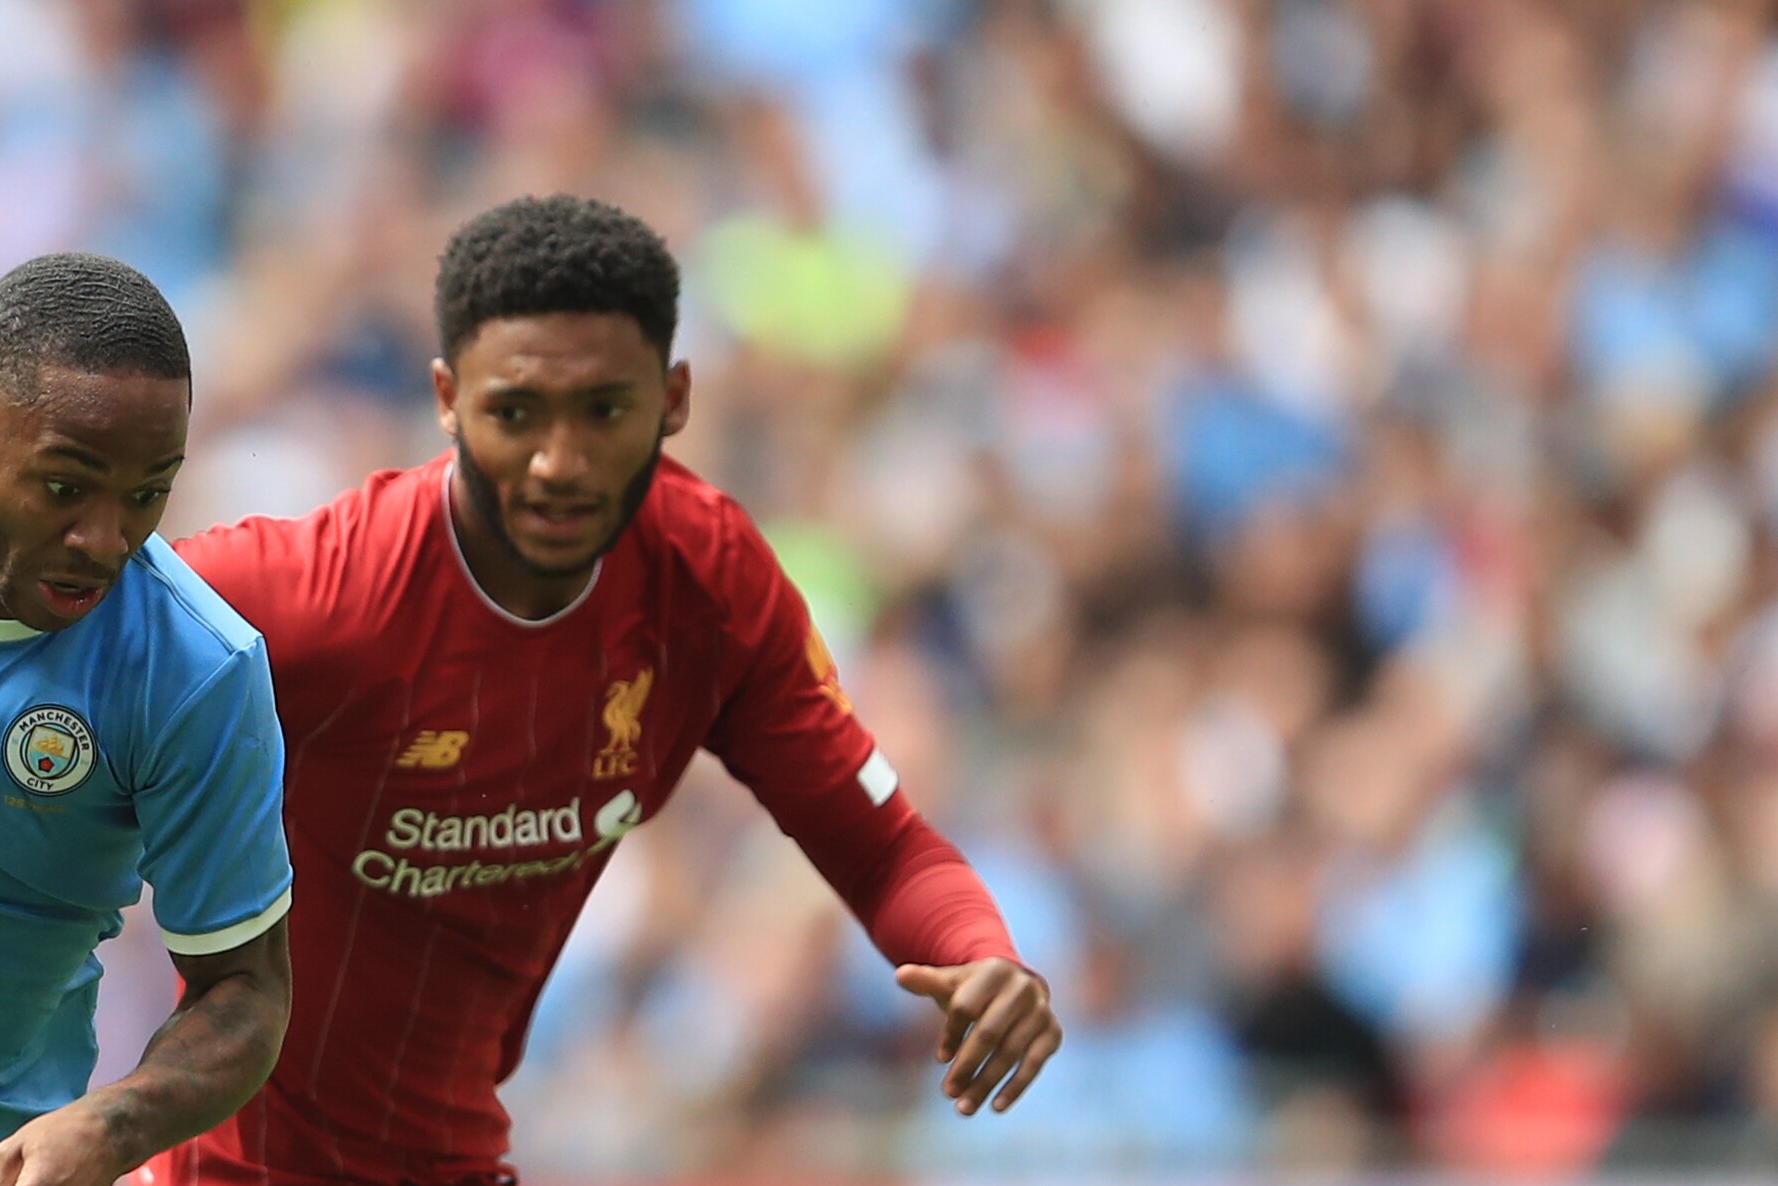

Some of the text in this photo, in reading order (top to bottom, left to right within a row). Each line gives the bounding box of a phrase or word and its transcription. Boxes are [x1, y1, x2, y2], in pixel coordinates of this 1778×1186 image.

[19, 711, 90, 751] MANCHESTER
[593, 755, 637, 778] LFC
[26, 777, 54, 790] CITY
[387, 798, 581, 849] Standard
